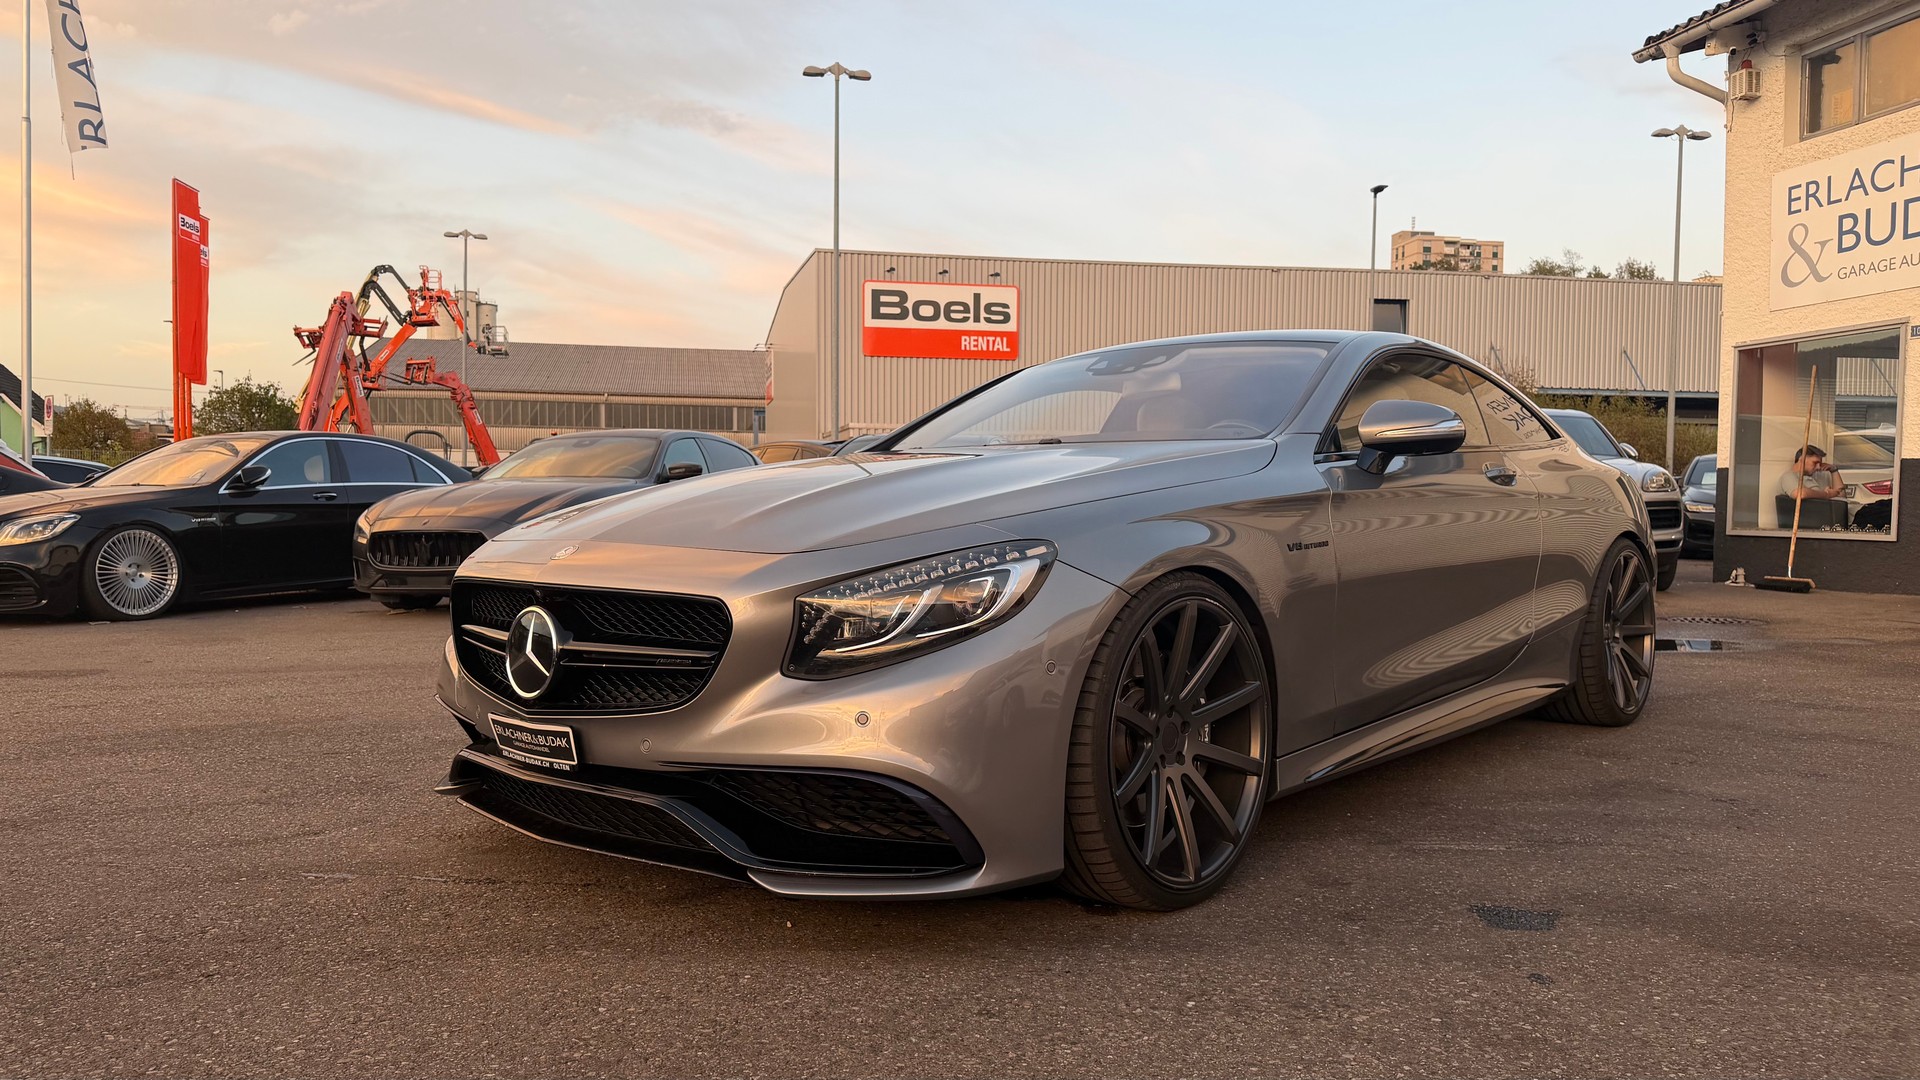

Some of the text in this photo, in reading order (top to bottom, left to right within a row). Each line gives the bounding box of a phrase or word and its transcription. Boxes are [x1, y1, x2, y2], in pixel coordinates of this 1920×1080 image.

[1787, 154, 1920, 216] ERLACH
[1780, 196, 1920, 289] & BUD
[1837, 256, 1897, 280] GARAGE
[871, 288, 1012, 325] Boels
[961, 335, 1011, 352] RENTAL
[502, 750, 570, 771] ERLACHNER-BUDAK.CH OLTEN
